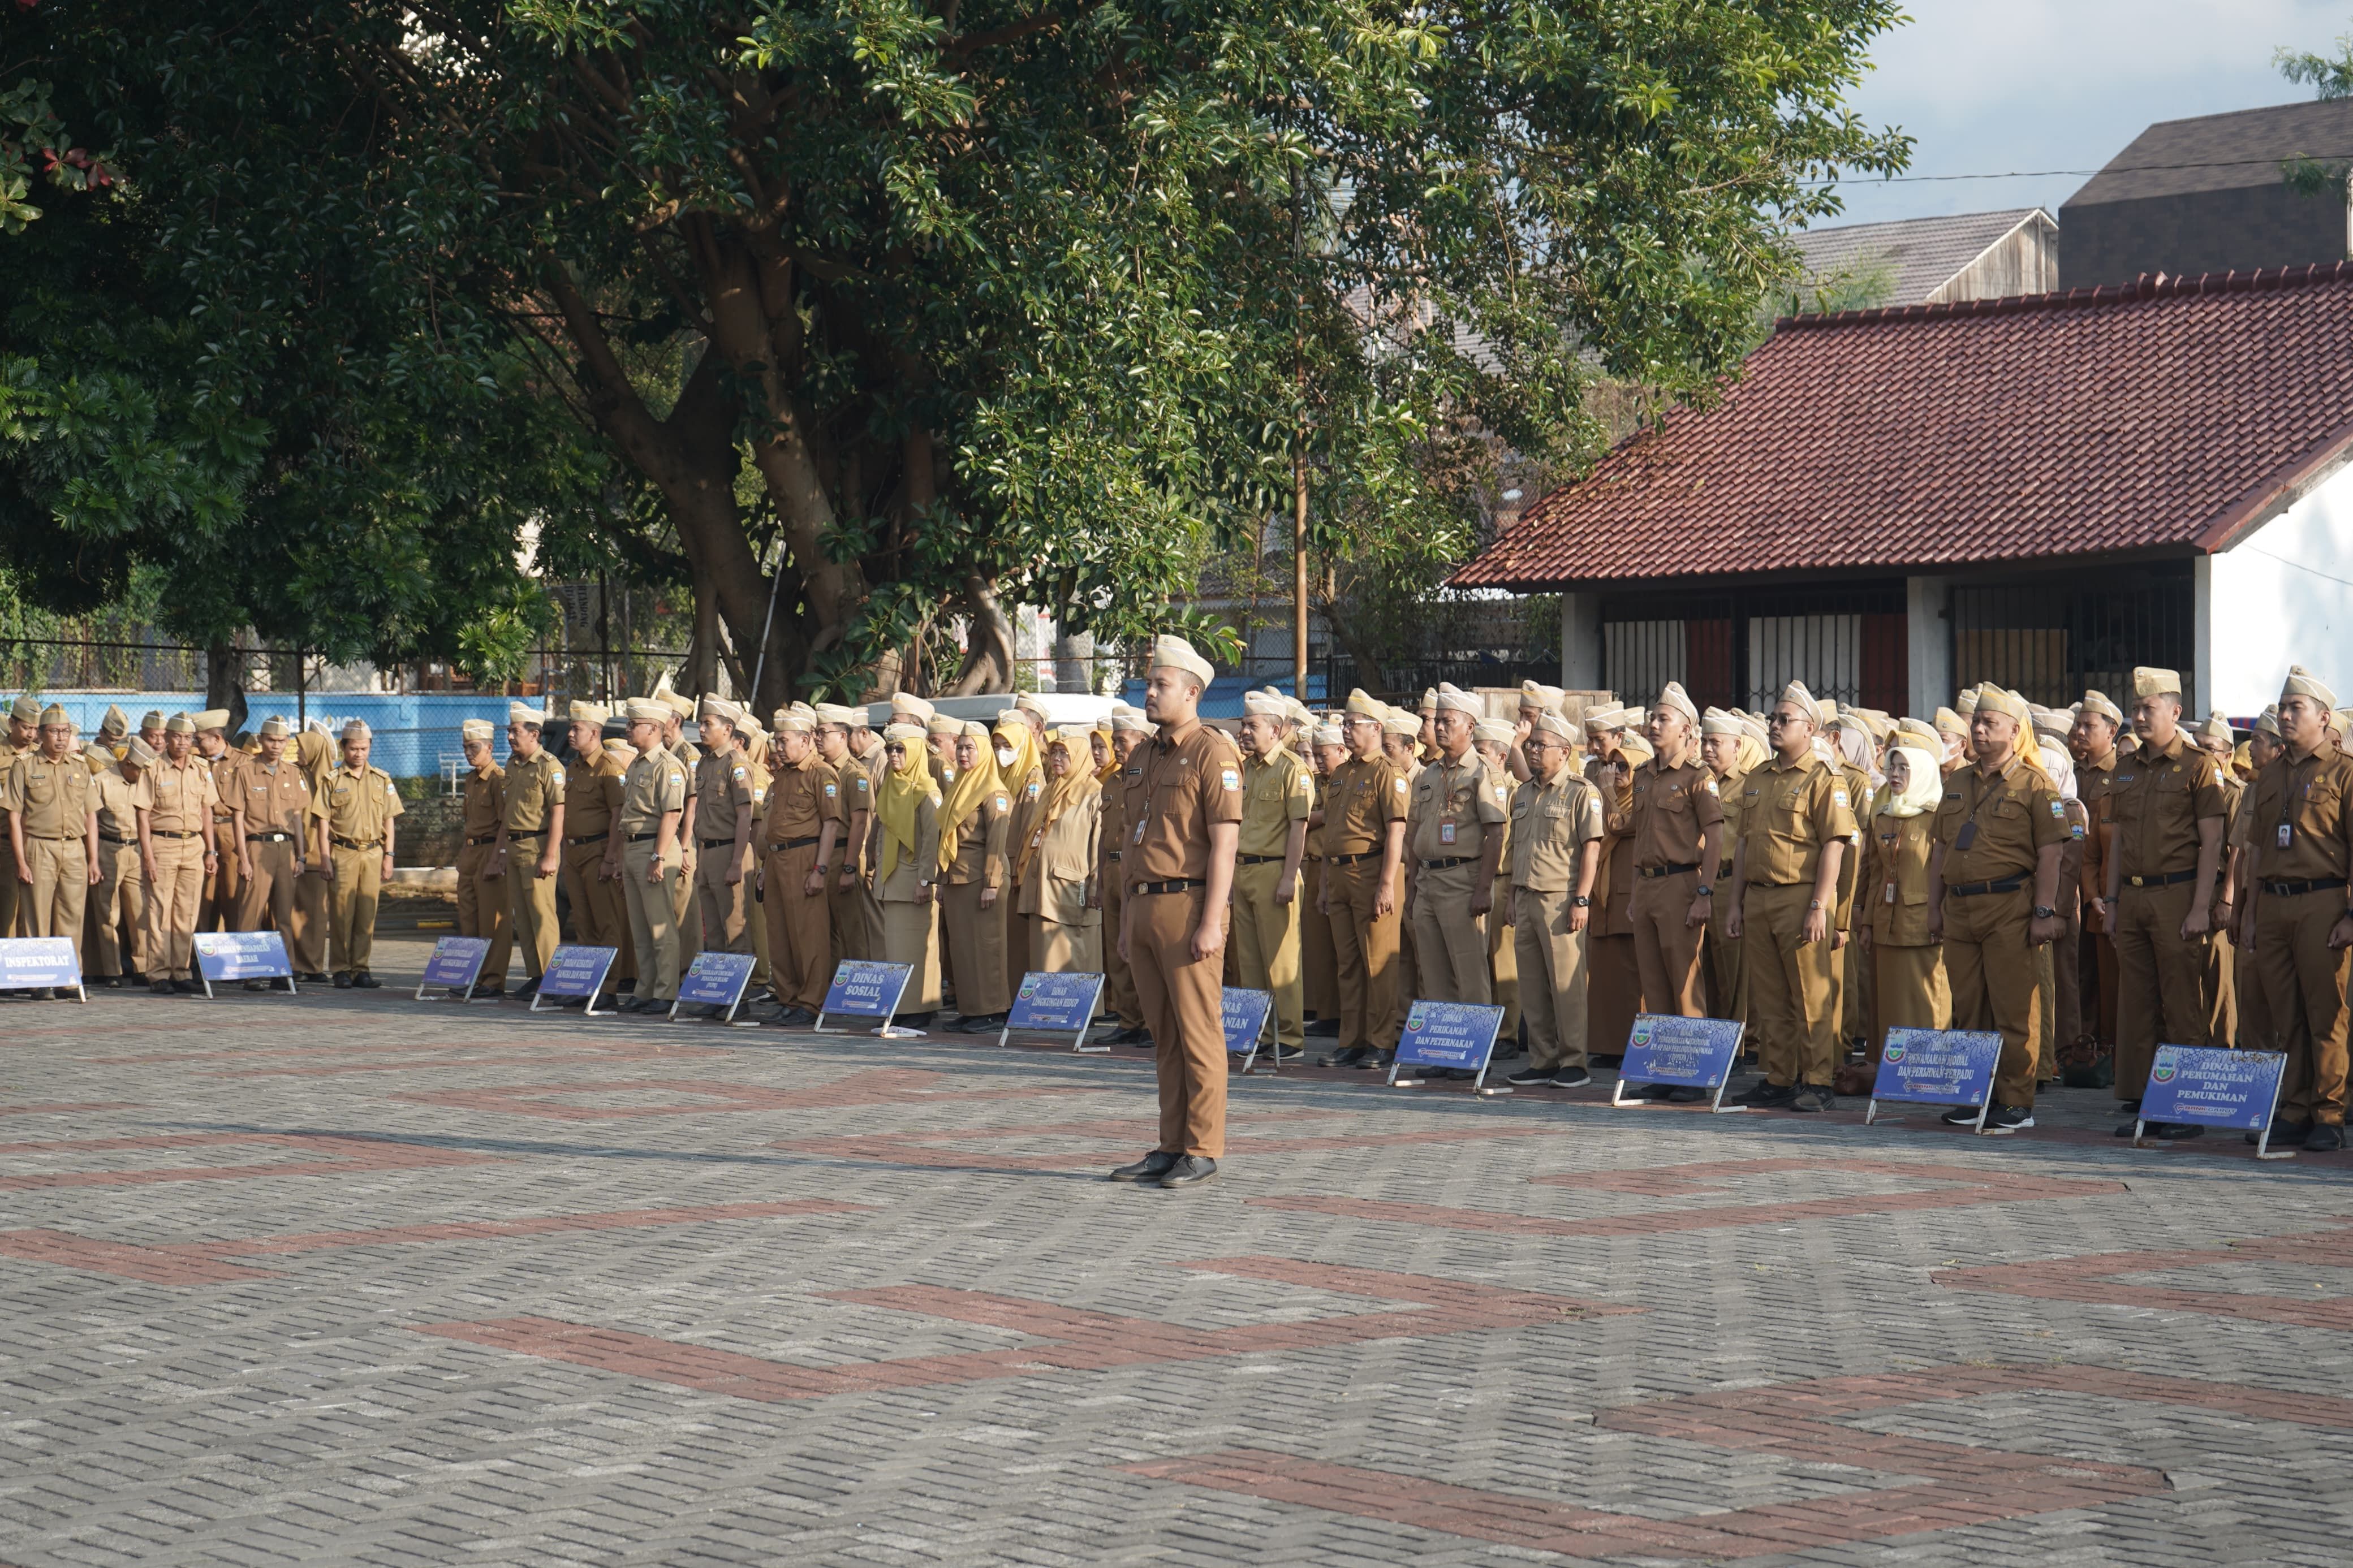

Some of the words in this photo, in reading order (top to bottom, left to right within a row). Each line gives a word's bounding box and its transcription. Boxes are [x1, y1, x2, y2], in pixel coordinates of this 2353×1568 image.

[5, 956, 69, 967] INSPEKTORAT
[852, 973, 885, 984] DINAS
[845, 986, 881, 997] SOSIAL
[1051, 987, 1068, 996] DINAS
[1032, 996, 1065, 1007] LINGKUNGAN
[1063, 999, 1079, 1007] HIDUP
[1442, 1014, 1463, 1022] DINAS
[1429, 1025, 1468, 1035] PERIKANAN
[1430, 1038, 1475, 1048] PETERNAKAN
[1947, 1055, 1968, 1066] MODAL
[1898, 1066, 1911, 1077] DAN
[2201, 1062, 2237, 1072] DINAS
[2180, 1070, 2254, 1082] PERUMAHAN
[2202, 1082, 2229, 1091] DAN
[2177, 1090, 2248, 1103] PEMUKIMAN
